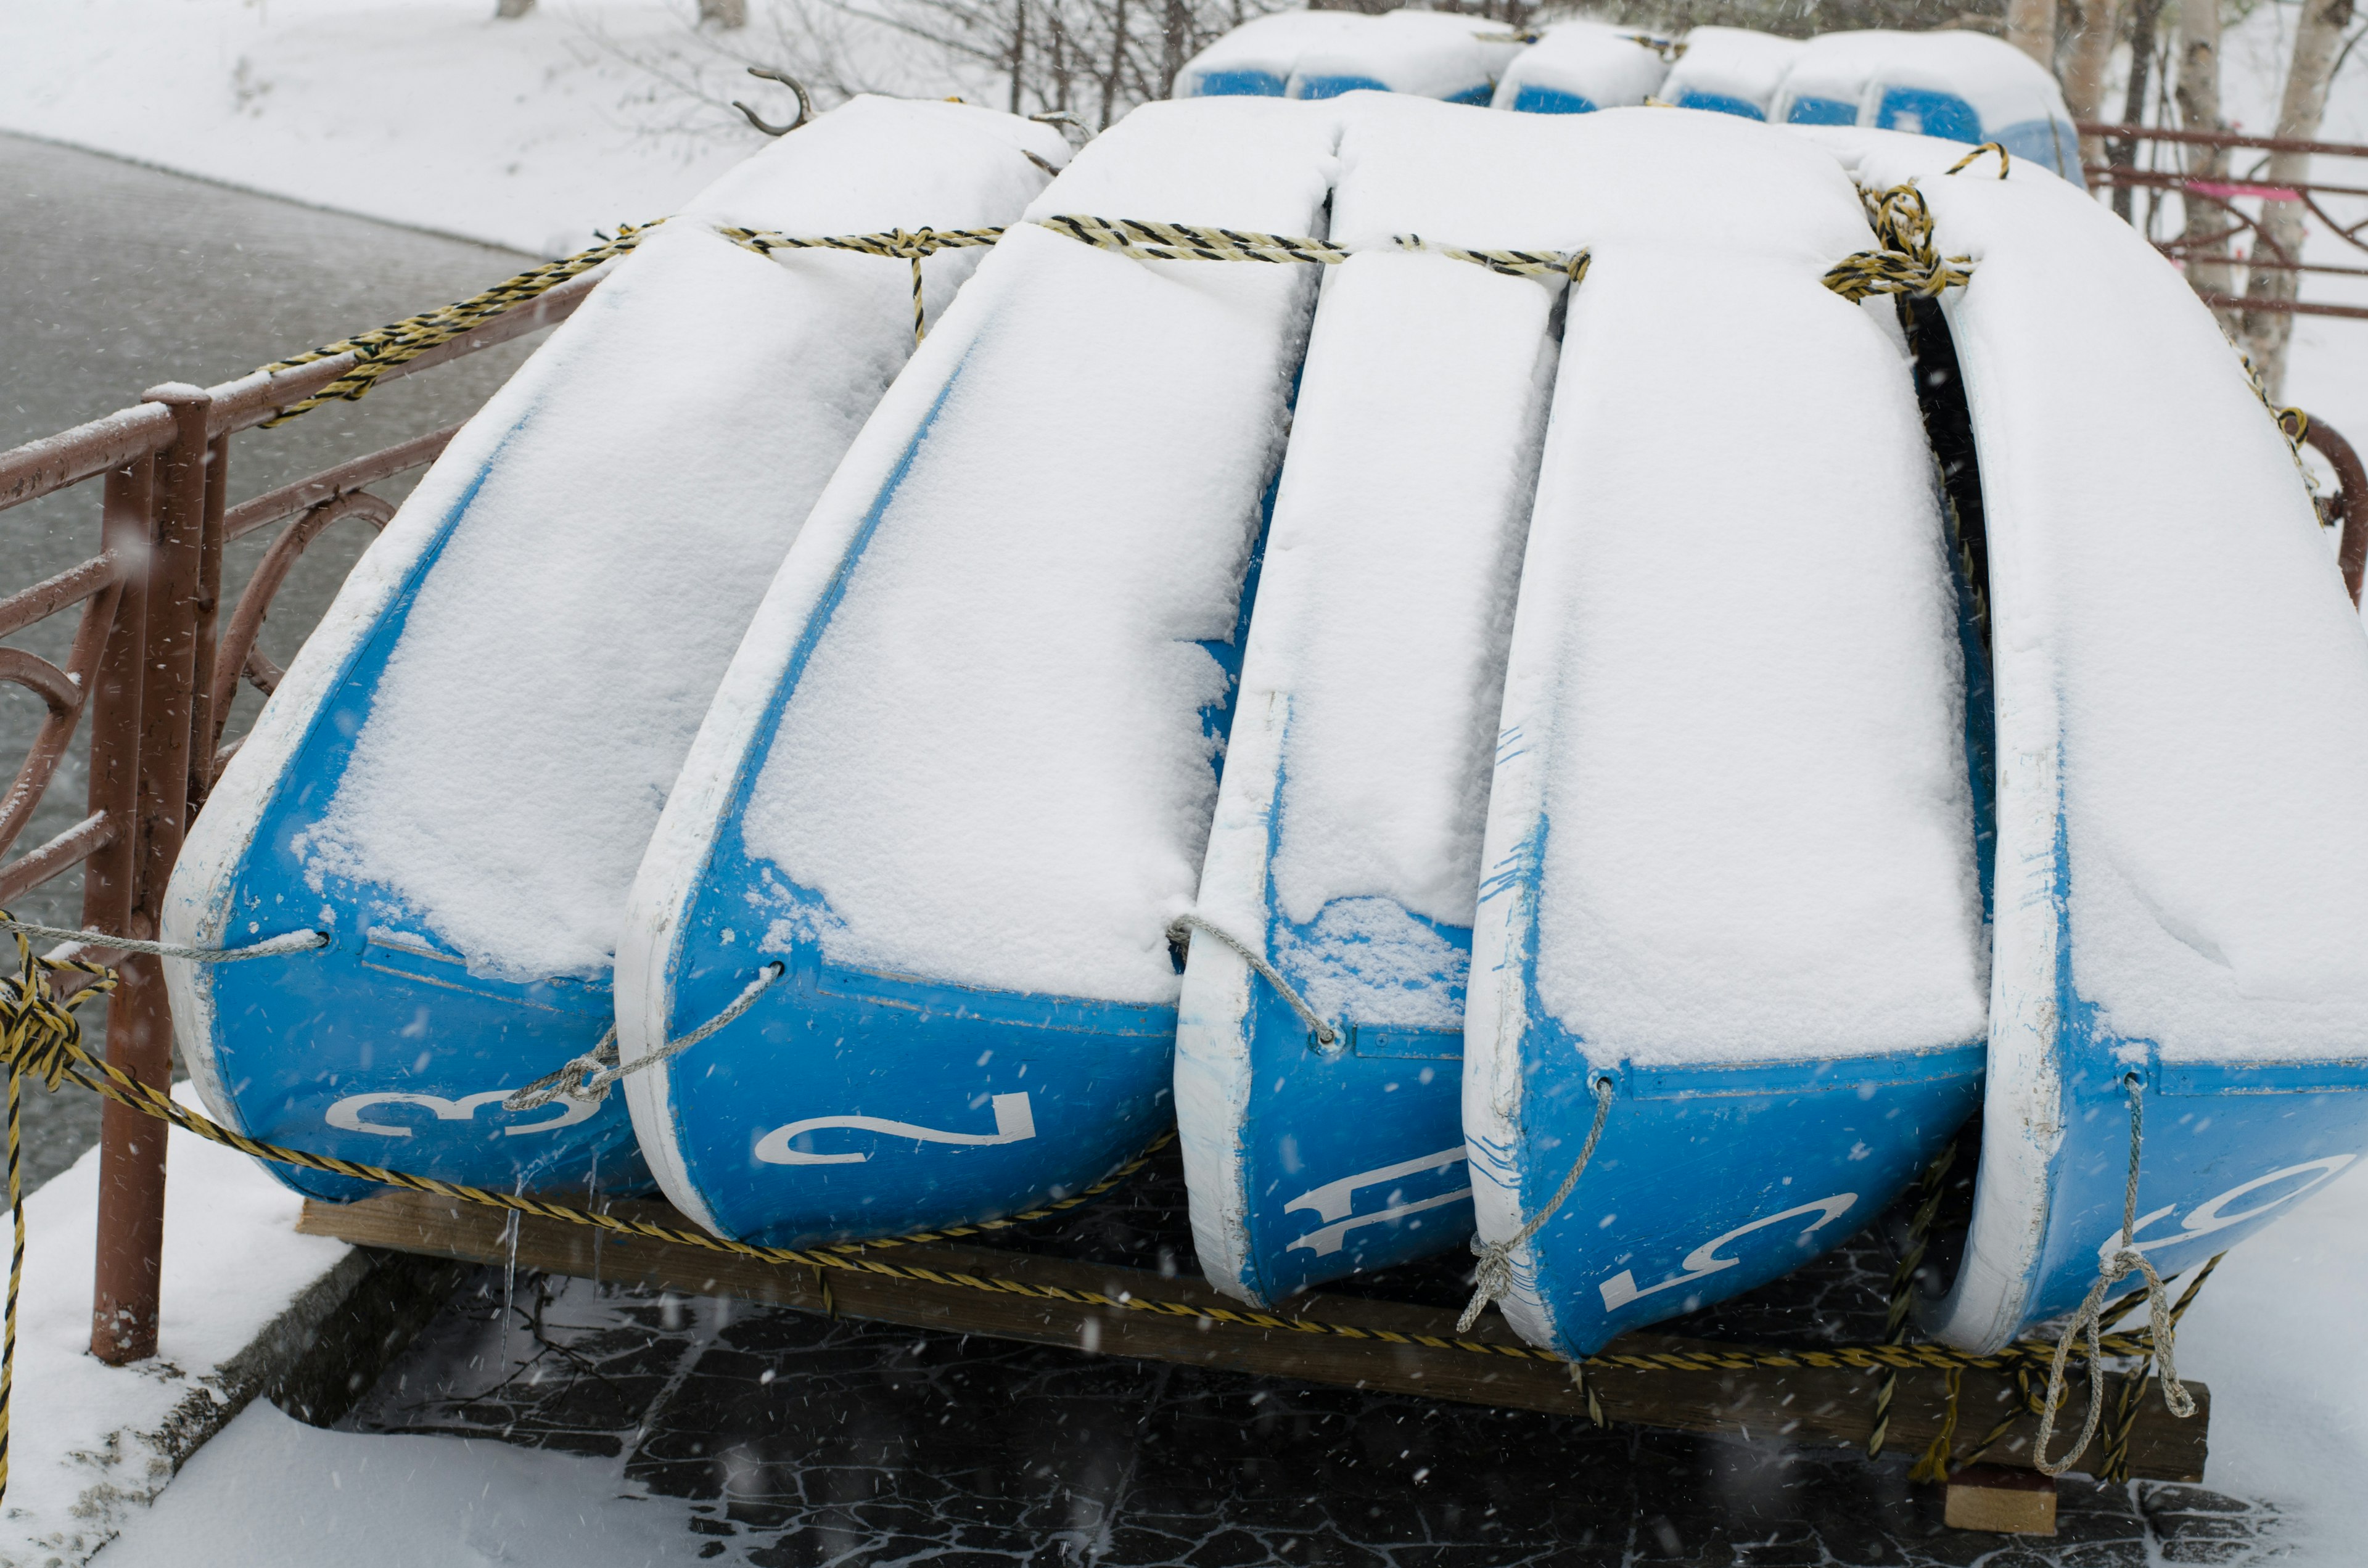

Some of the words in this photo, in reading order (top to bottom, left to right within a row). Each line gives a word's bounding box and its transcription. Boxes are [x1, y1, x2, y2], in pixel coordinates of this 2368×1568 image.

[325, 1090, 601, 1136] 3
[755, 1091, 1036, 1165] 2
[2098, 1154, 2357, 1257] 6
[1599, 1192, 1859, 1312] 5
